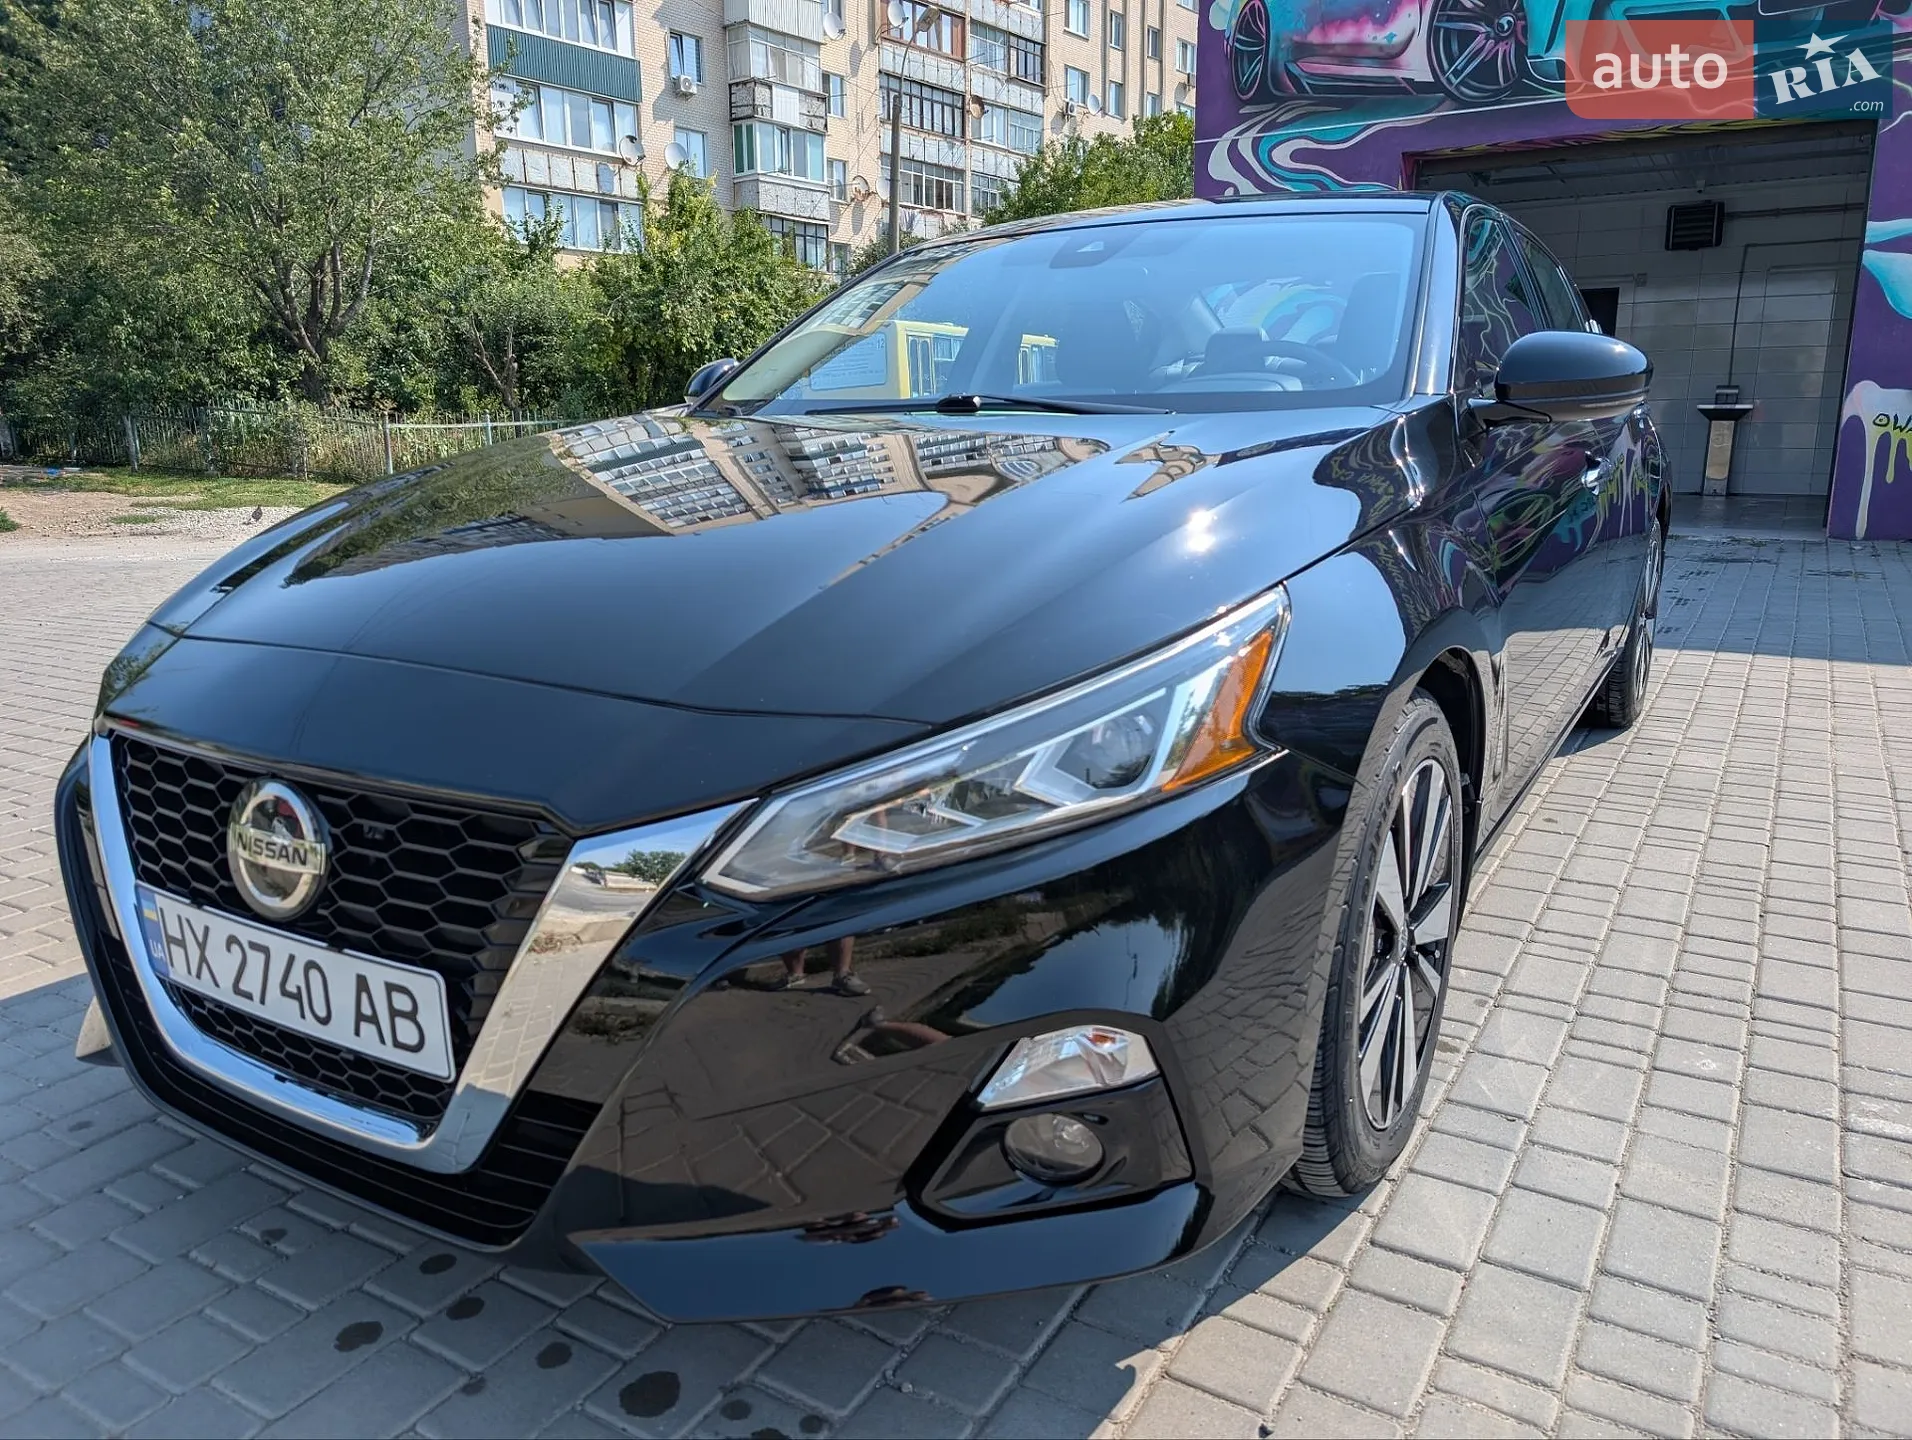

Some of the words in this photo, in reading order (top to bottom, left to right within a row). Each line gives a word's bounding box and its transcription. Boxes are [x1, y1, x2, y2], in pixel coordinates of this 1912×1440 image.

[237, 832, 308, 866] NISSAN
[150, 939, 166, 959] UA
[159, 907, 221, 988] HX
[225, 934, 332, 1026] 2740
[354, 973, 426, 1054] AB
